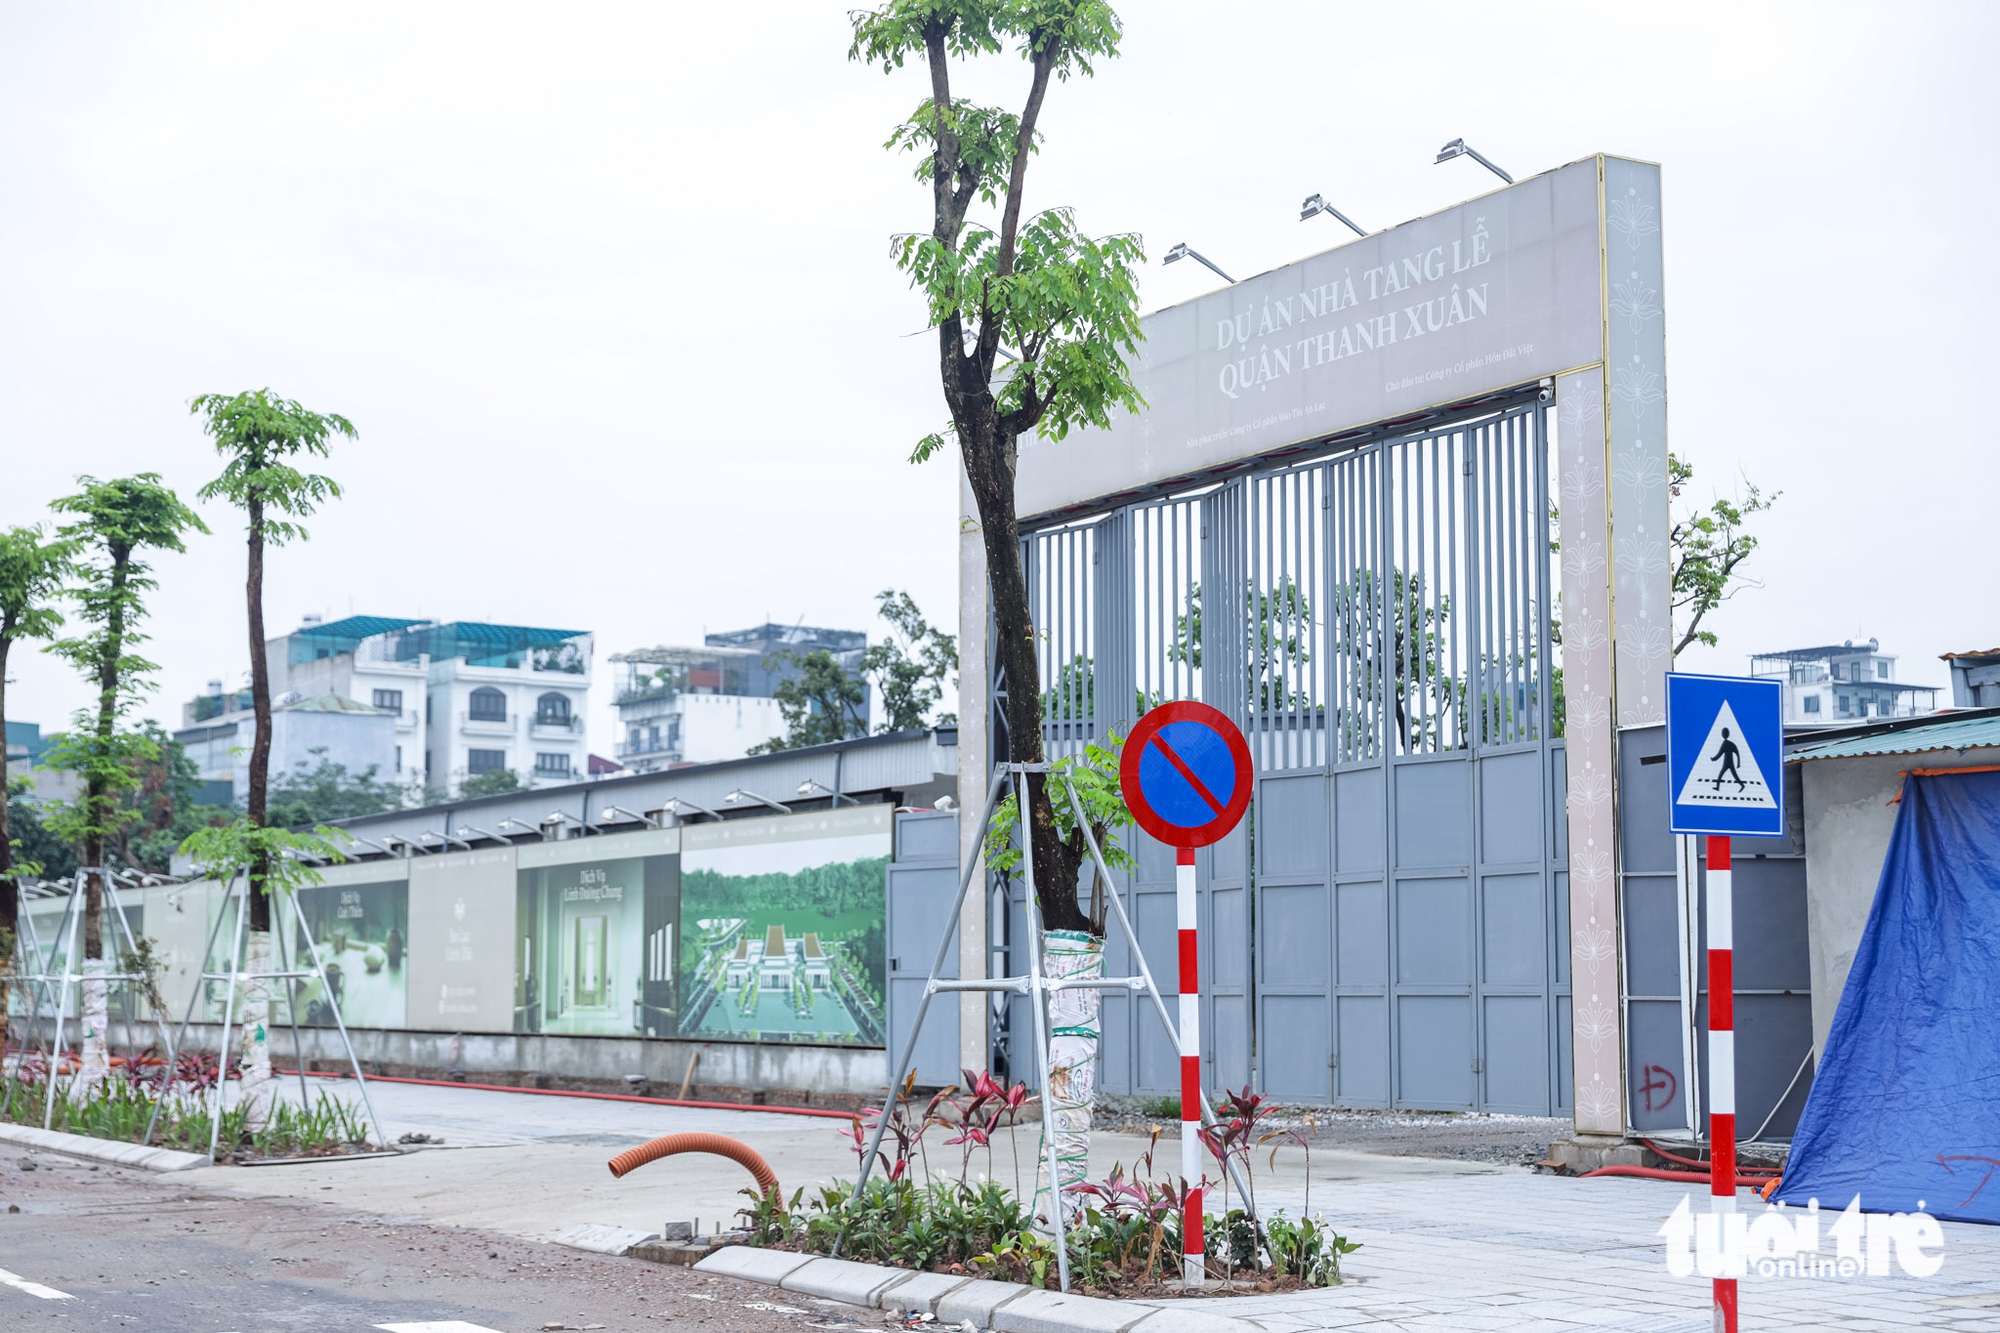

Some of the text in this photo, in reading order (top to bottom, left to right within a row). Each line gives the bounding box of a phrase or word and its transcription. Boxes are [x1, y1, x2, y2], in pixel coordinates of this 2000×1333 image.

[1217, 215, 1491, 351] DỰ ÁN NHÀ TANG LỄ
[1219, 283, 1489, 399] QUẬN THANH XUÂN
[1445, 366, 1453, 377] ty
